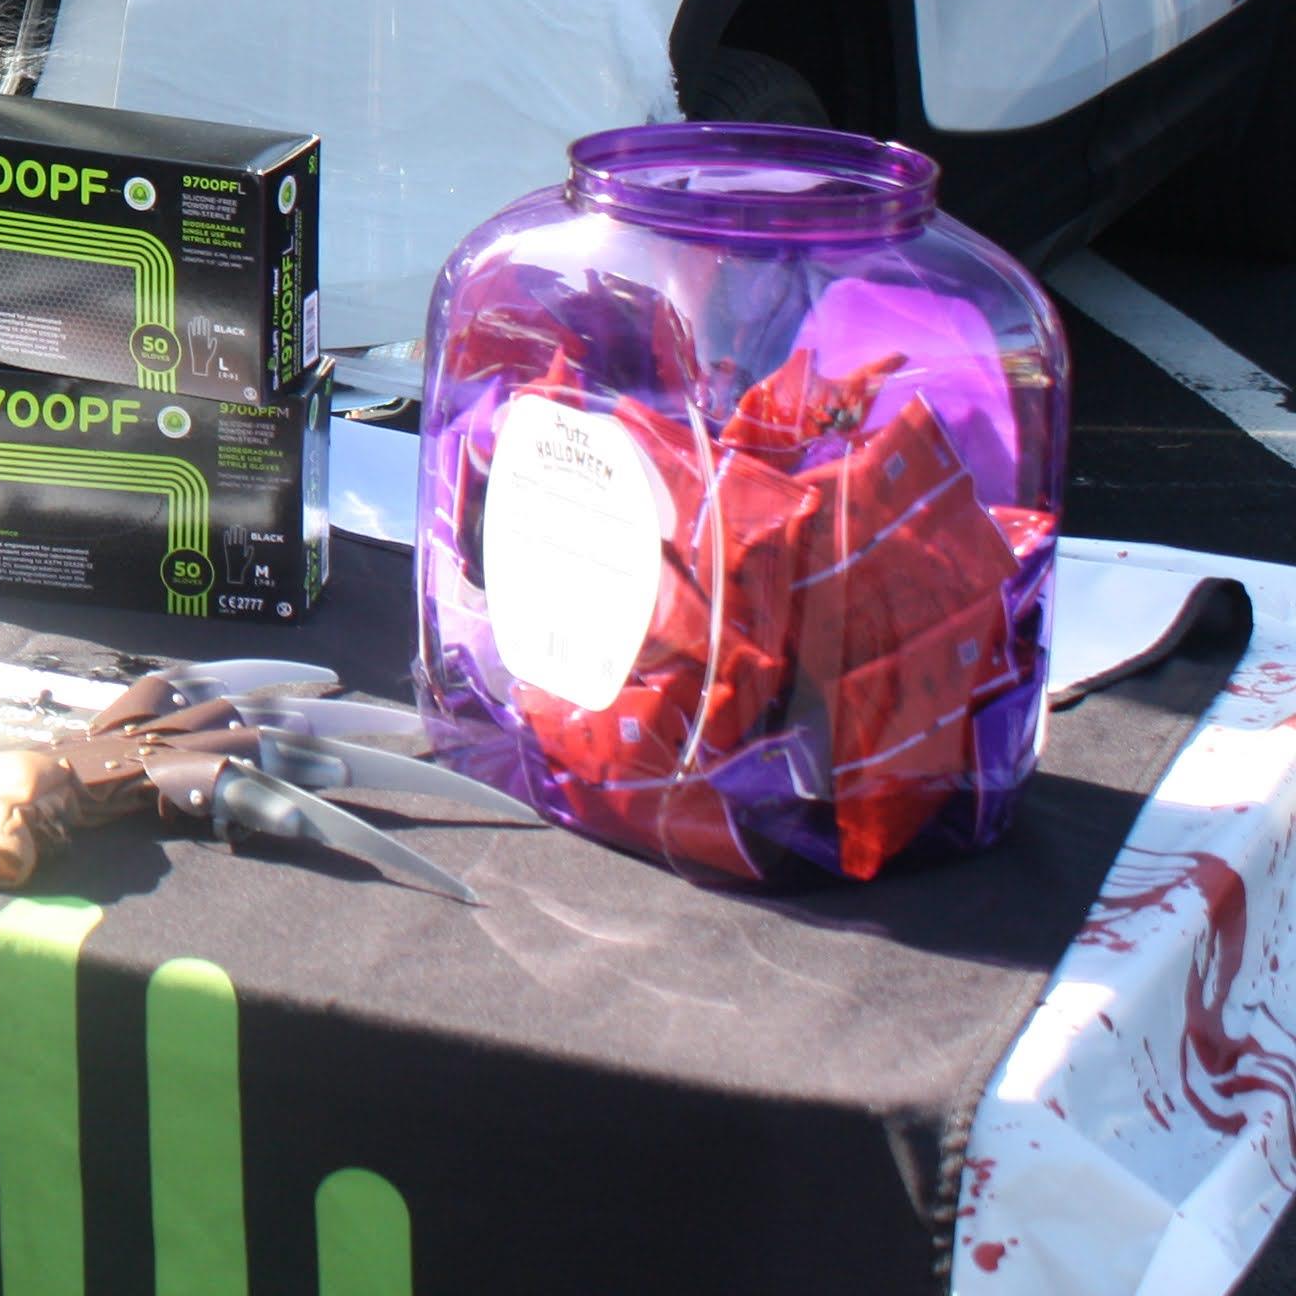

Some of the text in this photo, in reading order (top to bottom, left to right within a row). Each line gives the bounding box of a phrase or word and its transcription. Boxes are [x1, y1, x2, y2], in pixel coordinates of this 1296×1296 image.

[182, 175, 247, 195] 9700PFL
[213, 324, 246, 337] BLACK
[142, 336, 168, 354] 50
[219, 357, 229, 371] L
[535, 440, 613, 480] HALLOWEEN
[251, 532, 285, 544] BLACK
[175, 561, 201, 578] 50
[255, 565, 269, 578] M
